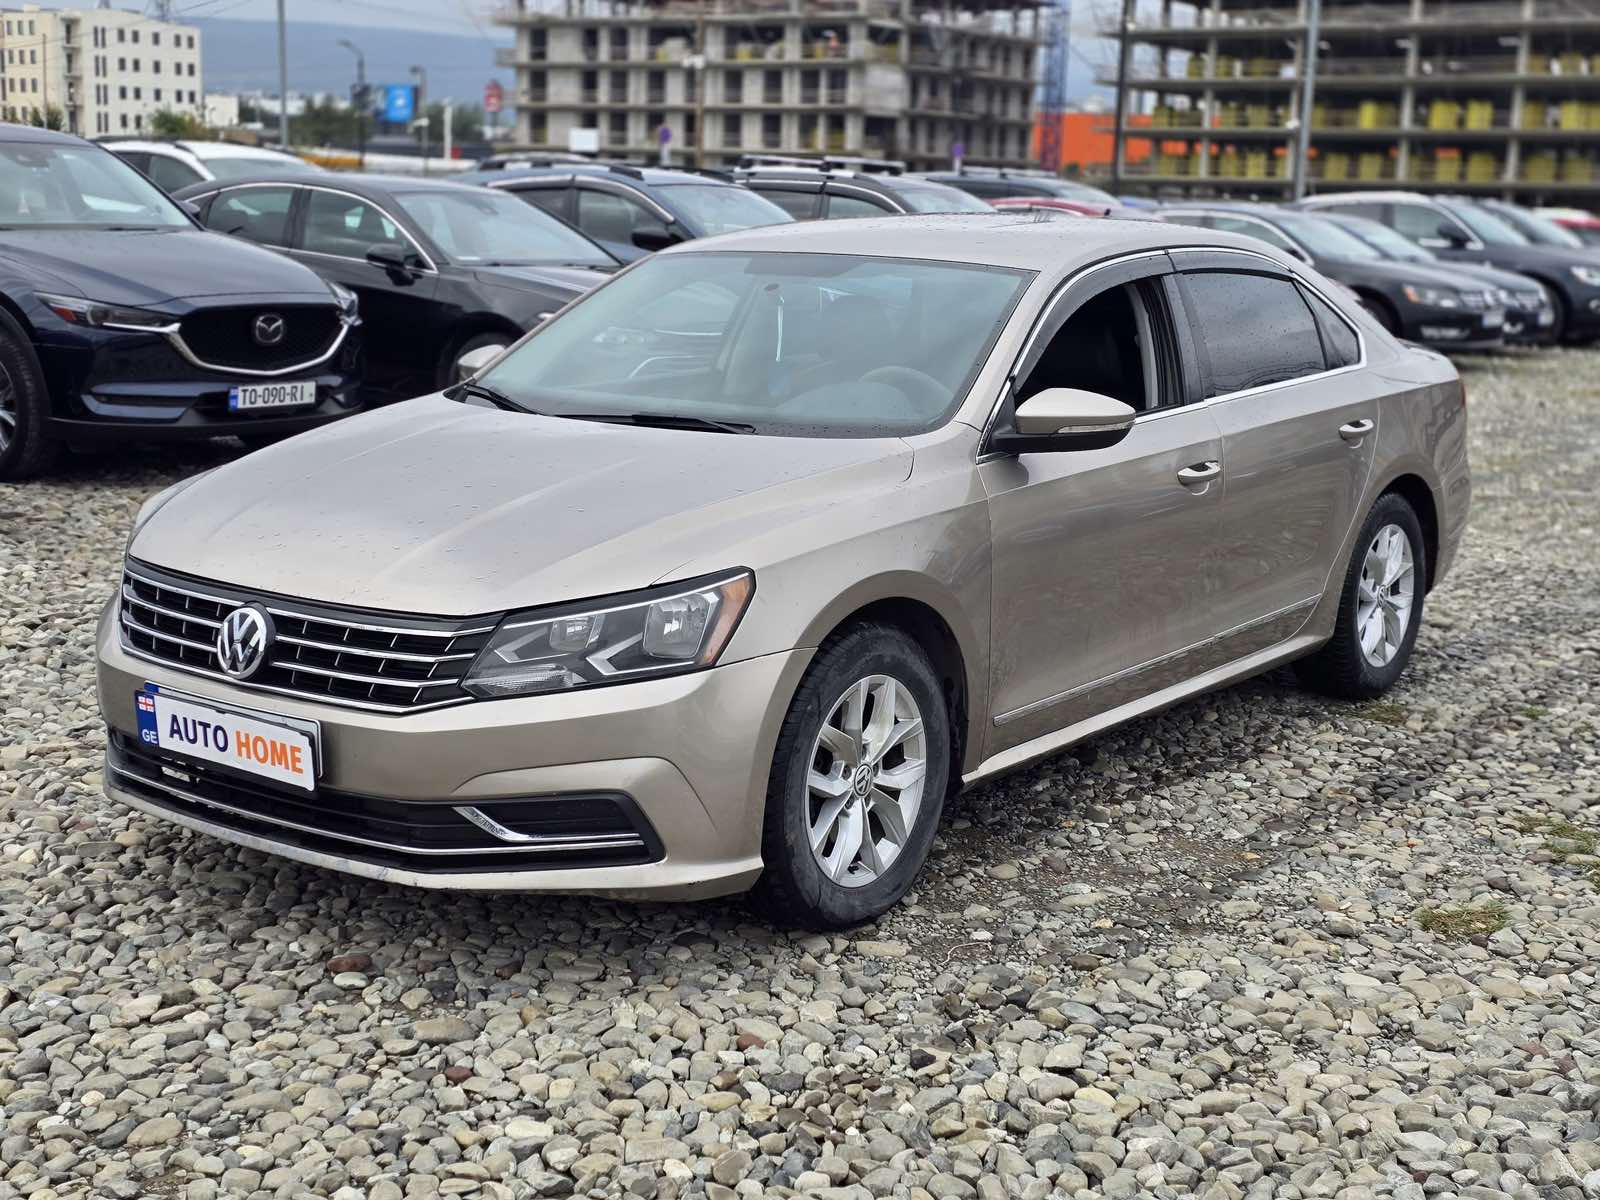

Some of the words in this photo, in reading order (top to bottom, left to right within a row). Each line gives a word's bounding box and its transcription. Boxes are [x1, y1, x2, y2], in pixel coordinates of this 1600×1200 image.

[241, 385, 304, 405] TO-090-RI
[142, 728, 158, 745] GE
[169, 714, 229, 753] AUTO
[235, 730, 304, 775] HOME
